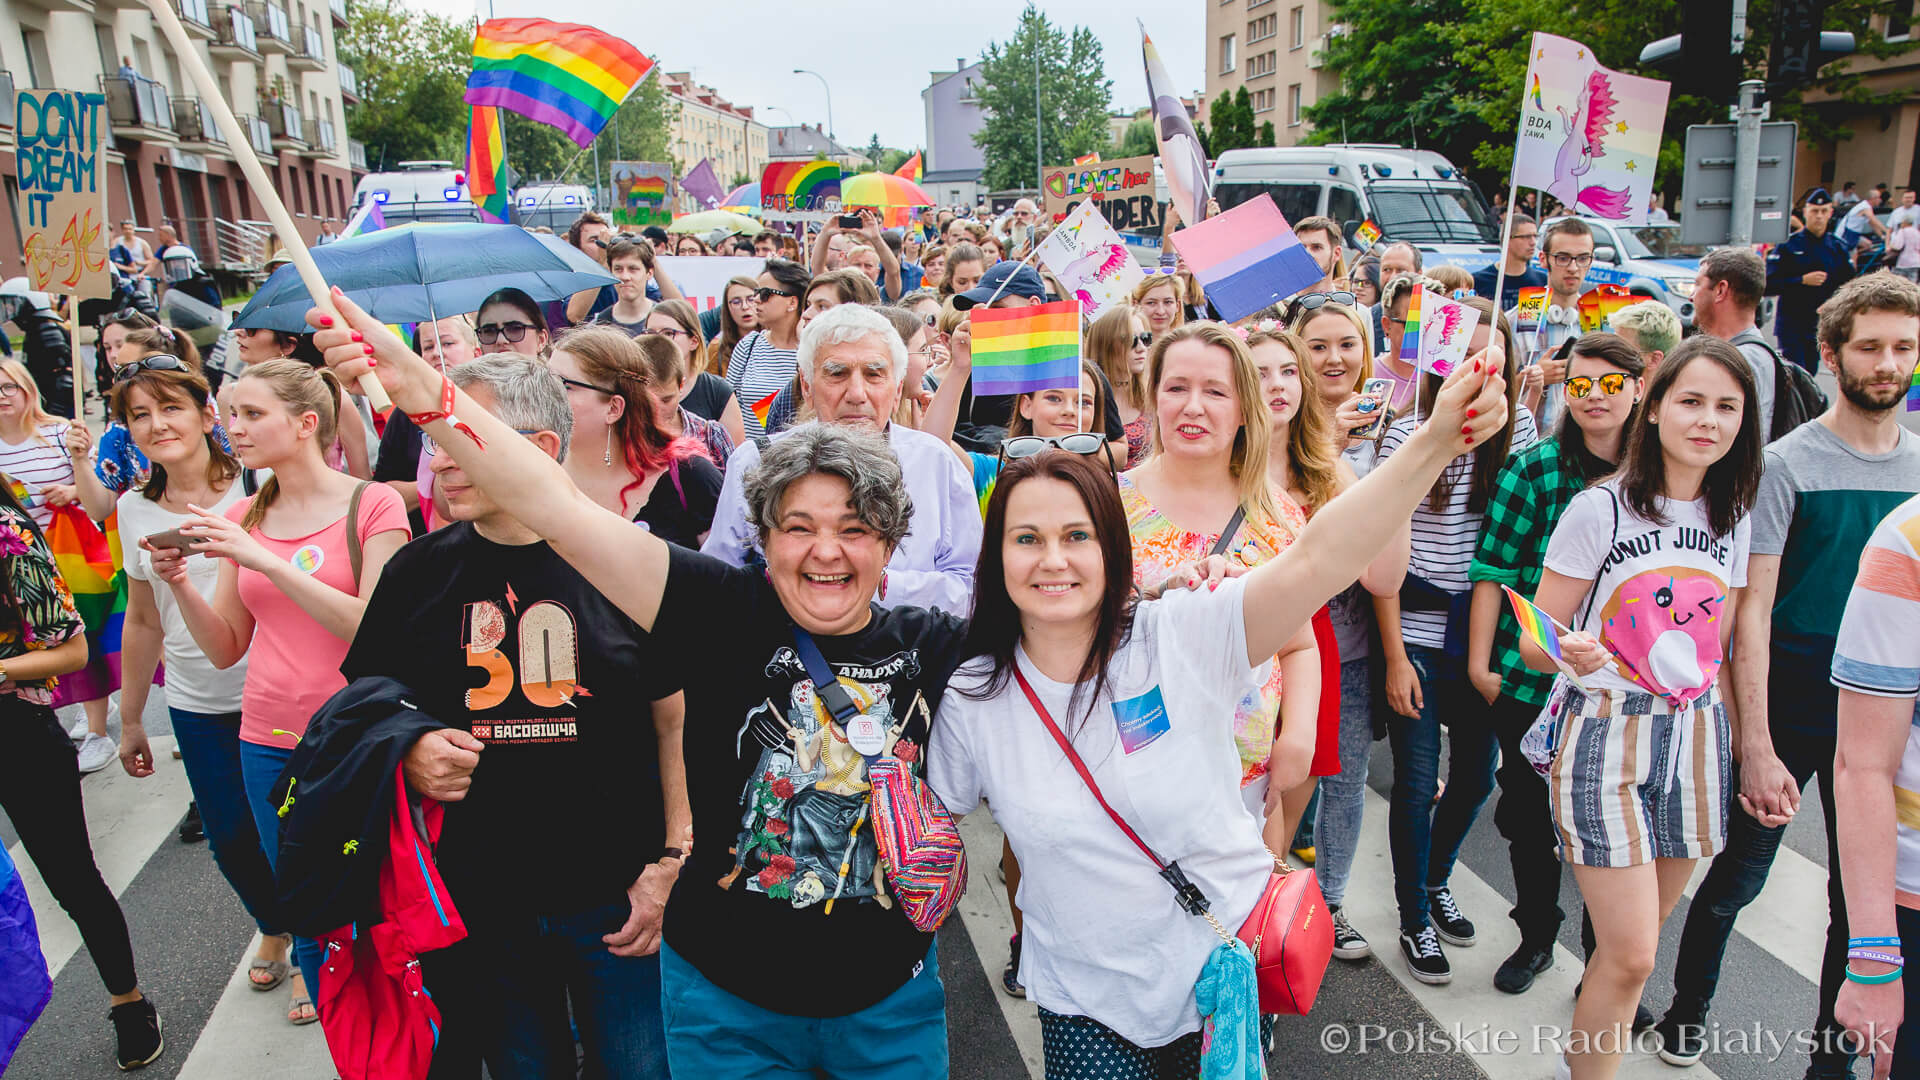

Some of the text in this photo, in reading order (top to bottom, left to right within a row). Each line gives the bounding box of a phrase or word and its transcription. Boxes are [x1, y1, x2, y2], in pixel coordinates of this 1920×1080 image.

[1526, 115, 1552, 131] BDA
[16, 146, 96, 193] DREAM
[1066, 167, 1121, 196] LOVE
[28, 193, 54, 228] IT
[1673, 526, 1729, 567] JUDGE
